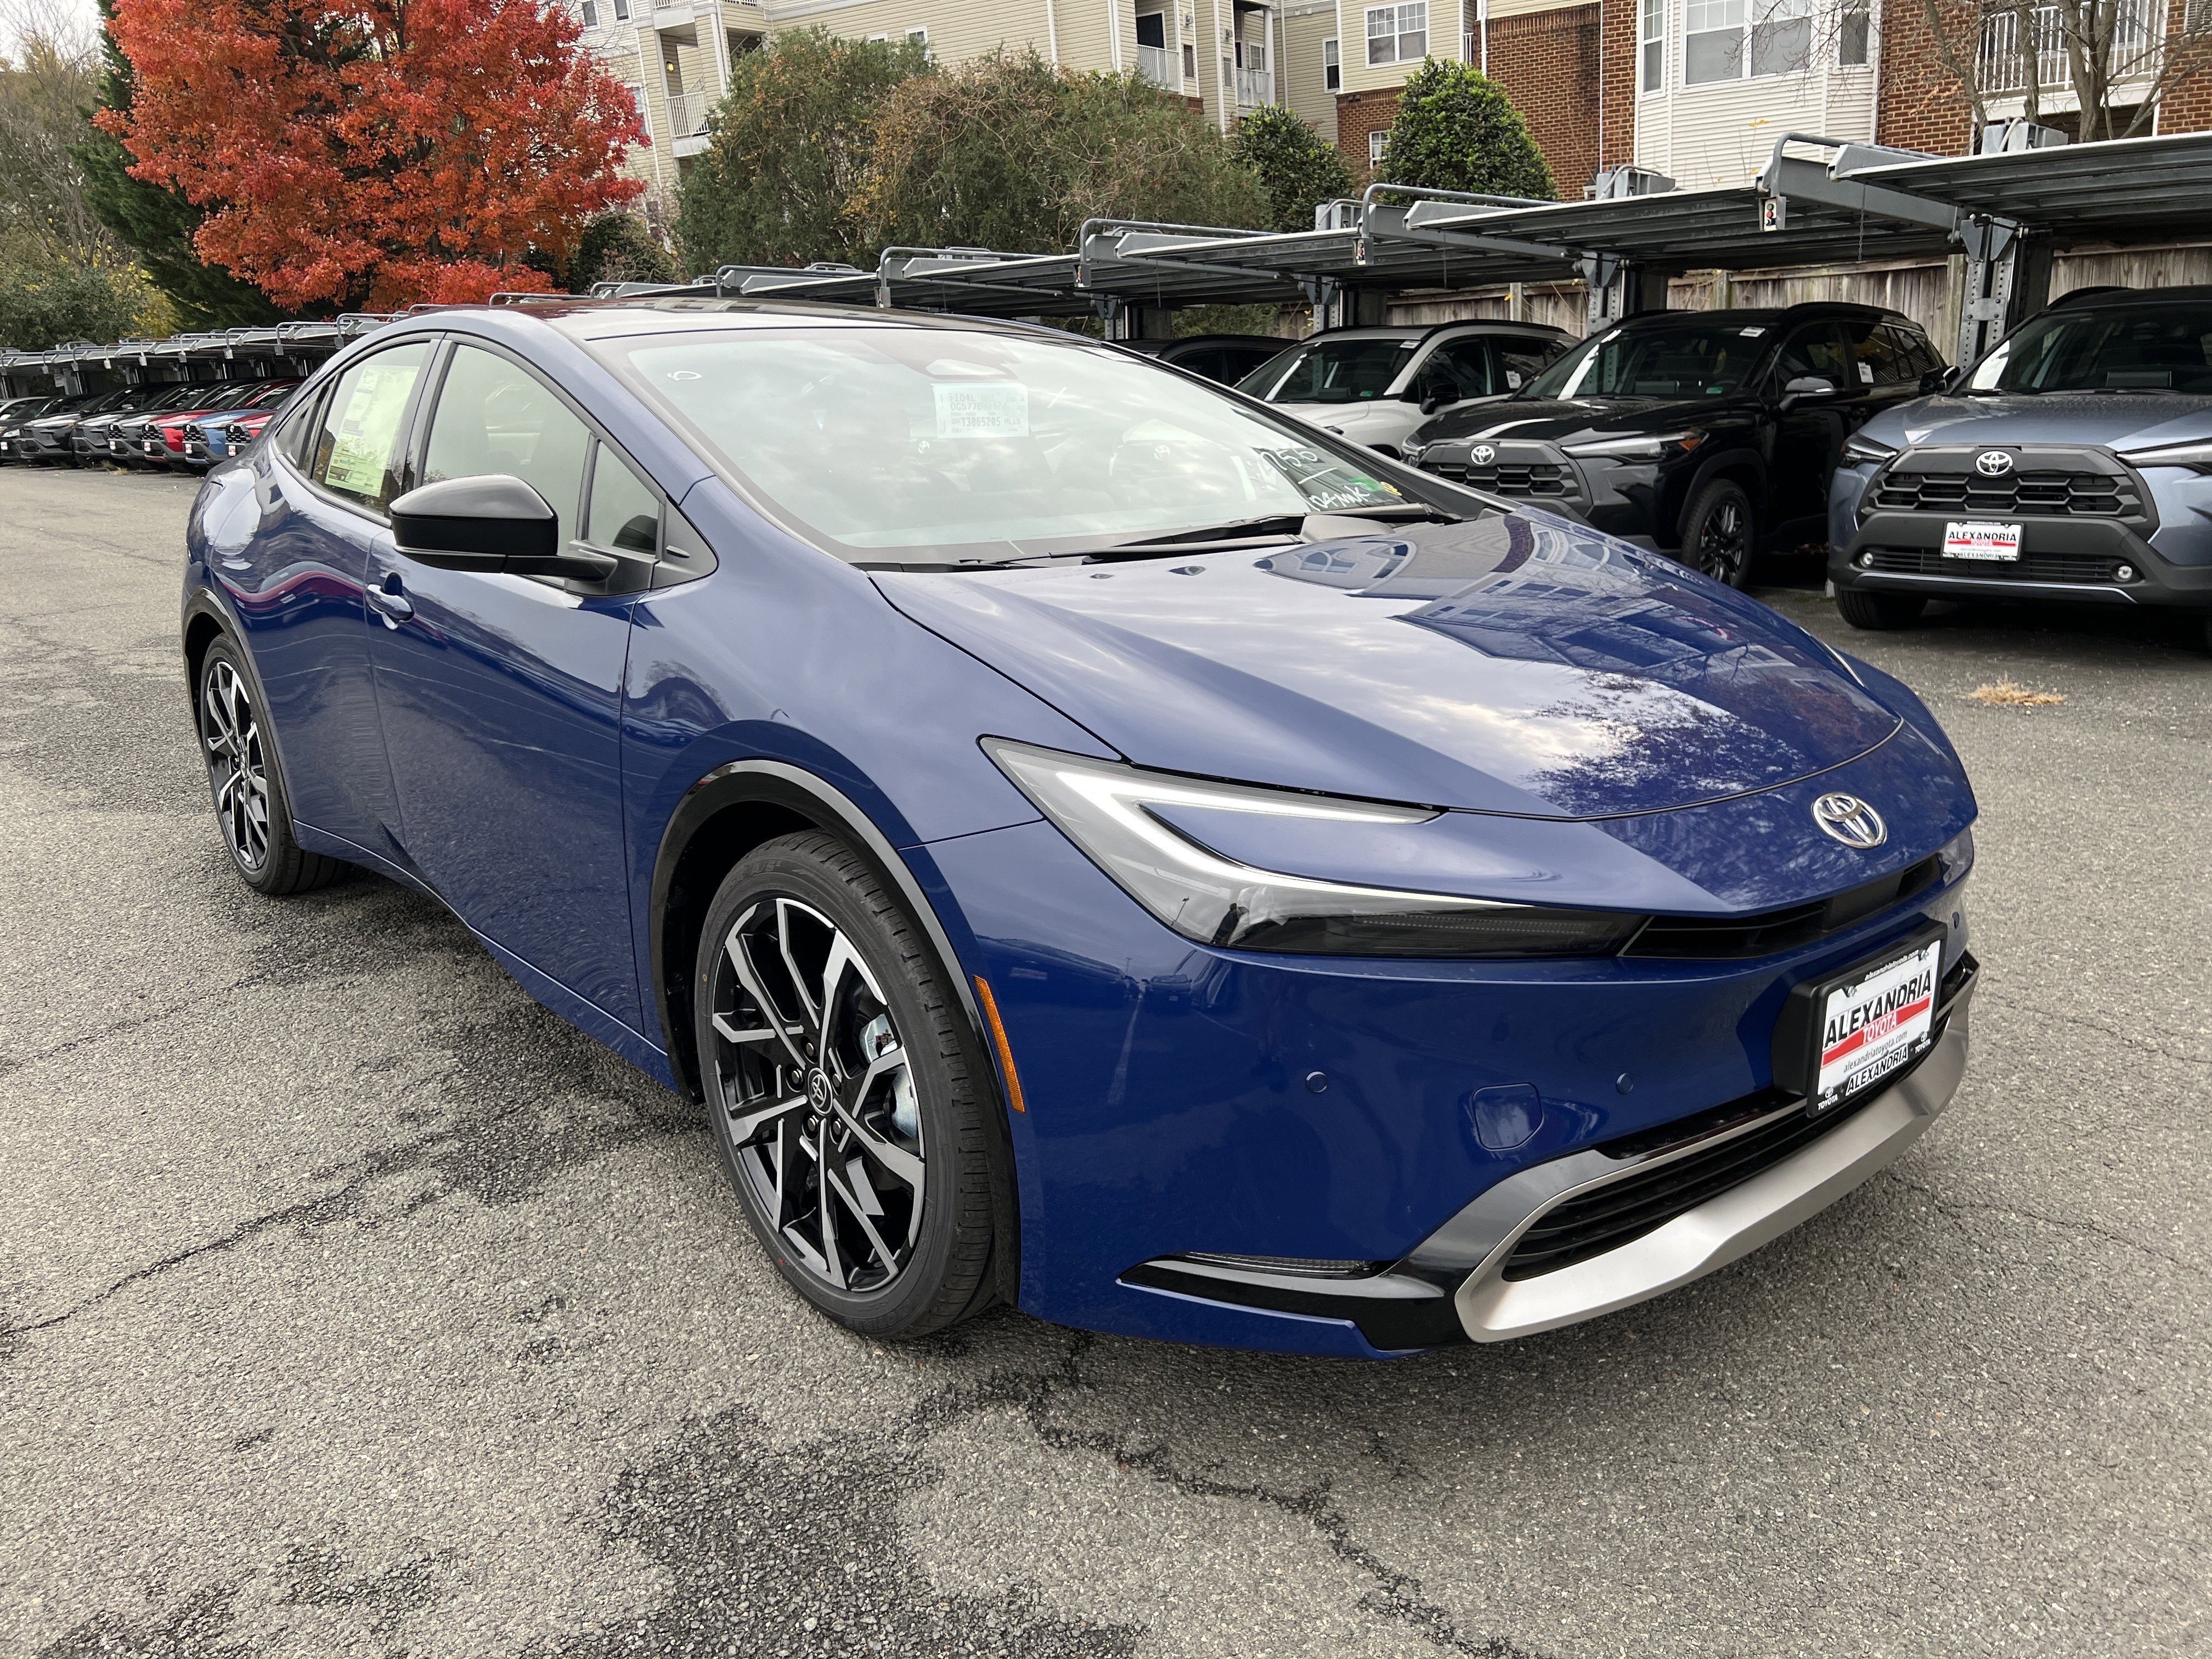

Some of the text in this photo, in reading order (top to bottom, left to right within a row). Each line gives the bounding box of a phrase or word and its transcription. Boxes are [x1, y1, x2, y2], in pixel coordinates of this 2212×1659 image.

[961, 417, 1001, 426] T3065205
[1949, 531, 2017, 541] ALEXANDRIA
[1824, 969, 1931, 1048] ALEXANDRIA
[1862, 1012, 1897, 1044] TOYOTA
[1843, 1030, 1908, 1073] alexandriatoyota.com
[1915, 1038, 1931, 1054] TOYOTA
[1846, 1048, 1908, 1094] ALEXANDRIA
[1818, 1093, 1838, 1111] TOYOTA
